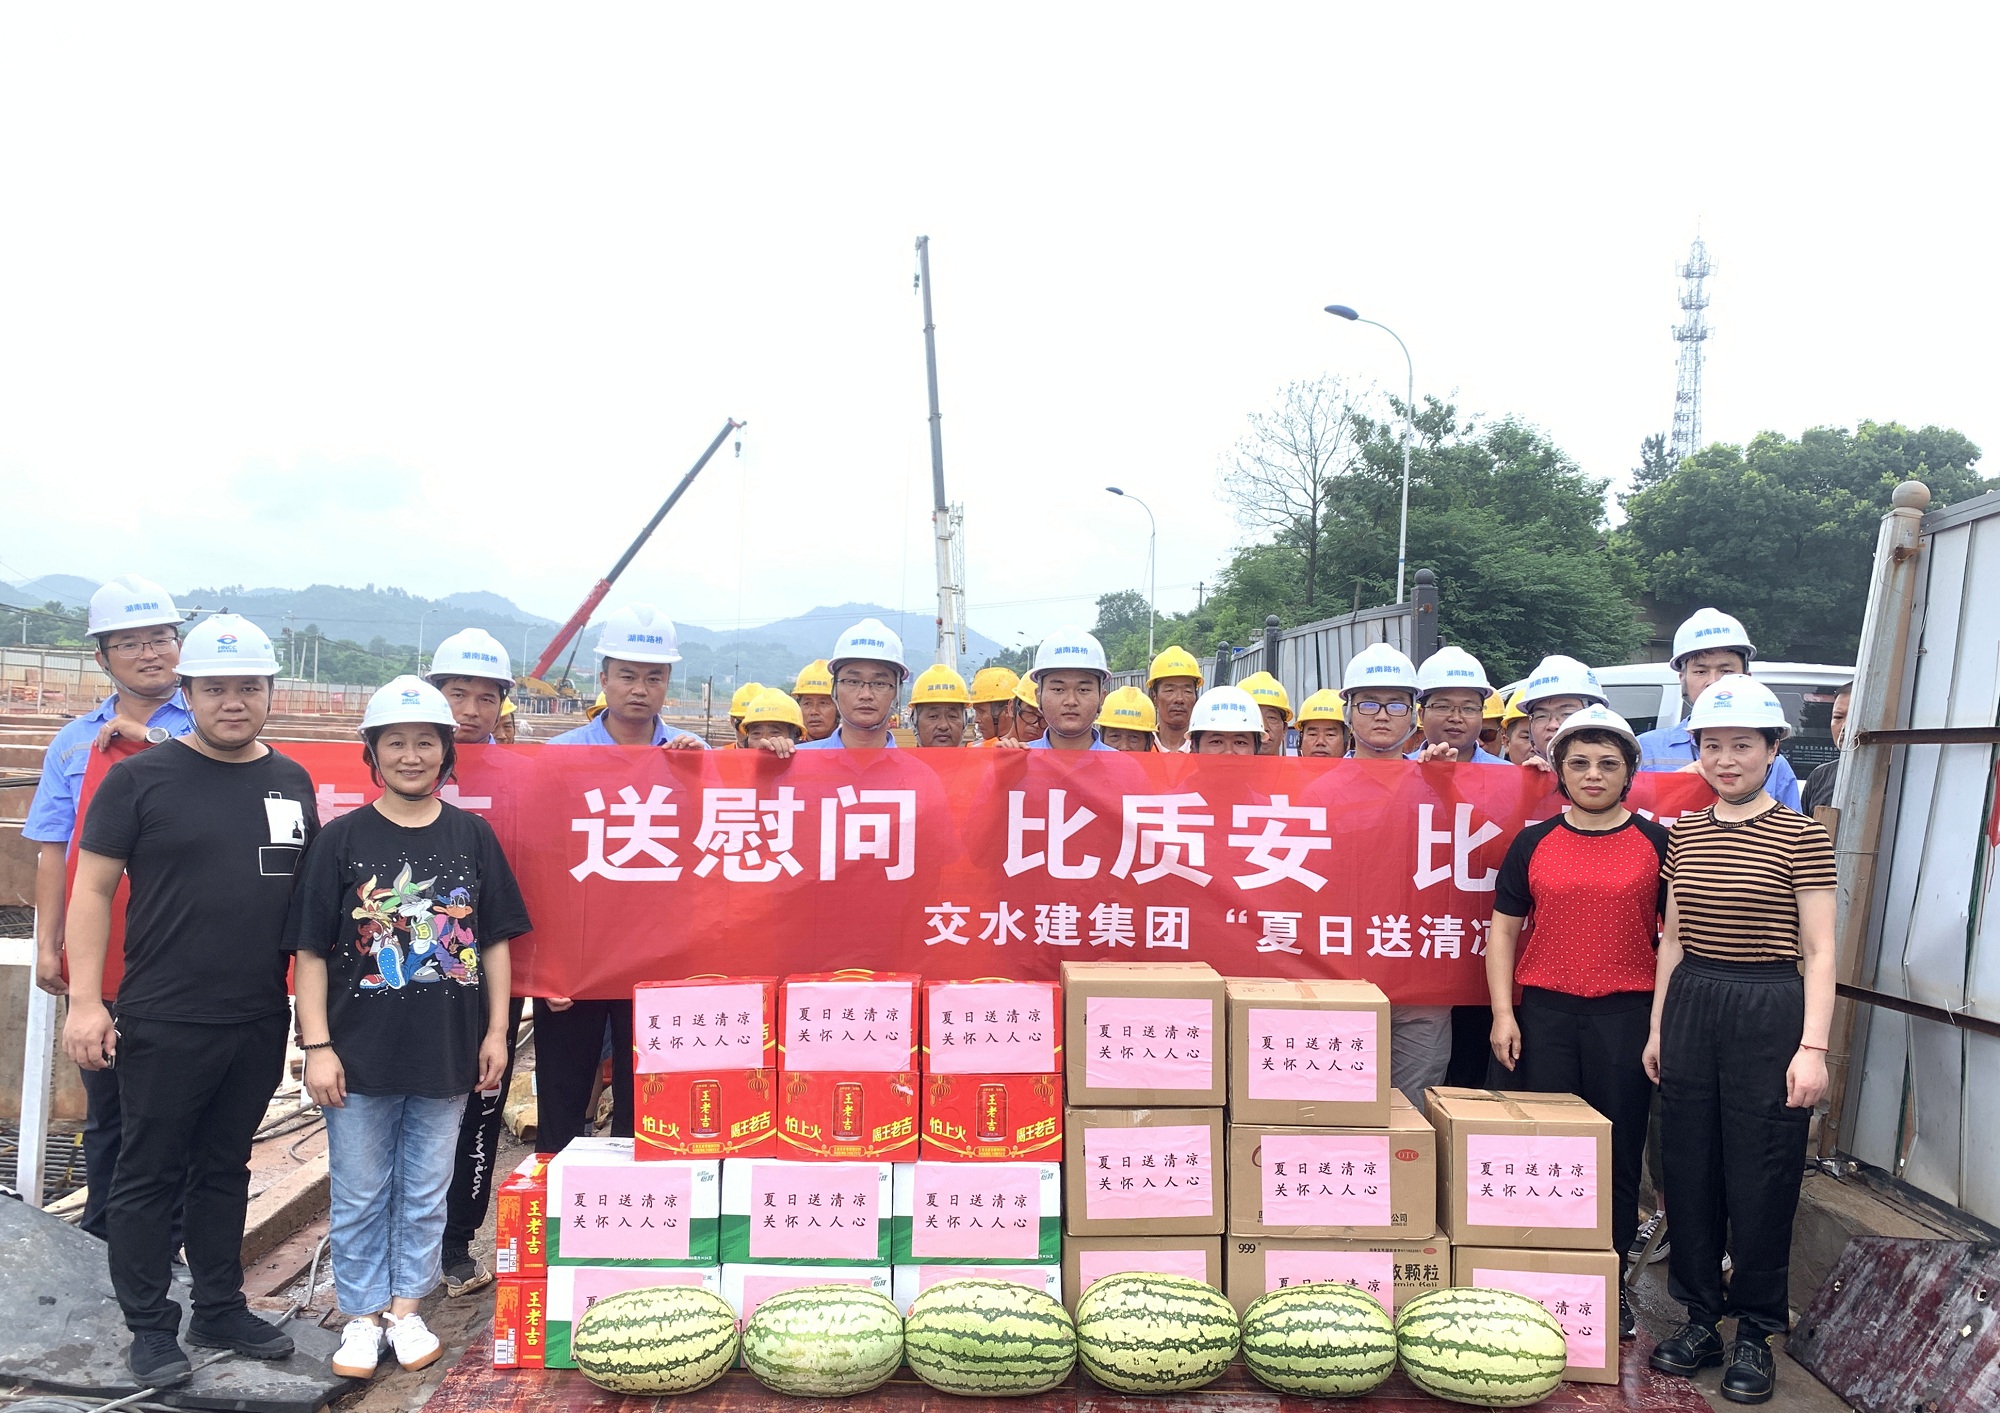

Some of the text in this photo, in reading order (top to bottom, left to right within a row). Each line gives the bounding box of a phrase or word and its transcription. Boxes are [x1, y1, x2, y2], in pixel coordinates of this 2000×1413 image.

[125, 602, 159, 613] 湖南路桥
[628, 634, 663, 645] 湖南路桥
[1695, 627, 1730, 638] 湖南路桥
[851, 638, 885, 648] 湖南路桥
[1054, 646, 1088, 655] 湖南路桥
[462, 651, 498, 664] 湖南路桥
[1366, 665, 1400, 674] 湖南路桥
[1529, 675, 1559, 688] 湖南路桥
[1211, 702, 1247, 712] 湖南路桥
[569, 784, 917, 883] 送慰问
[1002, 788, 1332, 893] 比质安
[923, 901, 1191, 950] 交水建集团
[648, 1011, 751, 1030] 夏日送清凉
[798, 1006, 899, 1022] 夏日送清凉
[942, 1008, 1041, 1025] 夏日送清凉
[798, 1028, 899, 1043] 关怀入人心
[942, 1031, 1042, 1046] 关怀入人心
[1099, 1023, 1200, 1040] 夏日送清凉
[648, 1034, 751, 1051] 关怀入人心
[1261, 1035, 1364, 1052] 夏日送清凉
[1099, 1045, 1200, 1060] 关怀入人心
[1261, 1056, 1364, 1072] 关怀入人心
[700, 1090, 711, 1128] 王老吉
[842, 1093, 854, 1131] 王老吉
[986, 1094, 997, 1132] 王老吉
[642, 1111, 771, 1140] 怕上火 喝王老吉
[785, 1115, 913, 1143] 怕上火 喝王老吉
[929, 1117, 1056, 1143] 怕上火 喝王老吉
[1098, 1152, 1199, 1170] 夏日送清凉
[1398, 1151, 1417, 1160] OTC
[1274, 1161, 1377, 1177] 夏日送清凉
[1480, 1161, 1584, 1178] 夏日送清凉
[1098, 1175, 1200, 1191] 关怀入人心
[1274, 1182, 1378, 1197] 关怀入人心
[1480, 1182, 1585, 1198] 关怀入人心
[574, 1192, 678, 1209] 夏日送清凉
[763, 1192, 866, 1208] 夏日送清凉
[926, 1192, 1028, 1209] 夏日送清凉
[573, 1214, 677, 1229] 关怀入人心
[763, 1214, 866, 1229] 关怀入人心
[925, 1214, 1027, 1229] 关怀入人心
[1390, 1214, 1408, 1223] 公司
[525, 1200, 543, 1255] 王老吉
[1238, 1243, 1256, 1253] 999
[524, 1291, 542, 1347] 王老吉
